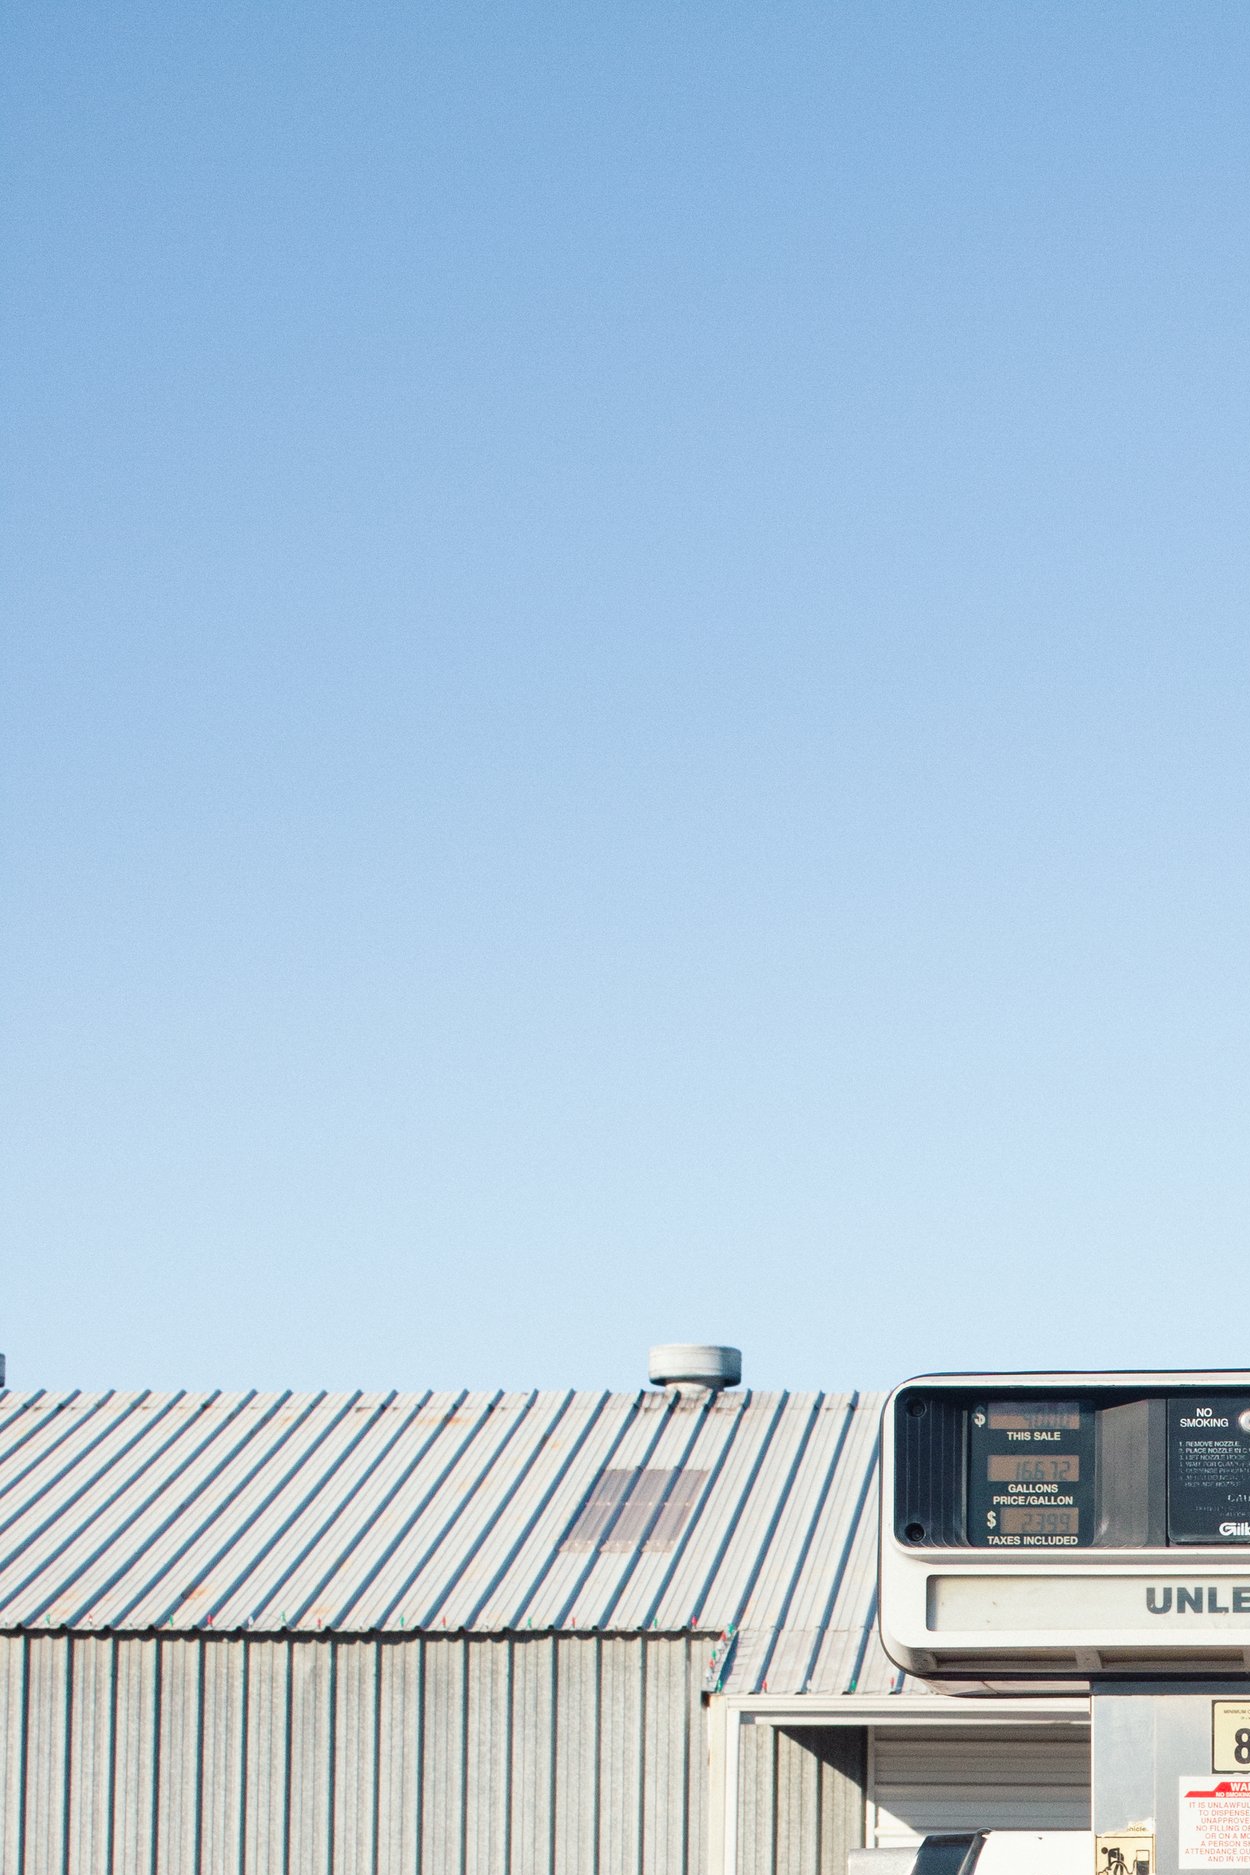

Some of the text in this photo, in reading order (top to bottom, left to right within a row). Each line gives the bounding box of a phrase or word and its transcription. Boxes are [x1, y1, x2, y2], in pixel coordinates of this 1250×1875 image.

[1196, 1408, 1212, 1417] NO
[1180, 1418, 1229, 1427] SMOKING
[1007, 1432, 1061, 1440] THIS SALE
[1008, 1484, 1058, 1493] GALLONS
[993, 1496, 1073, 1505] PRICE/GALLON
[987, 1510, 996, 1529] $
[987, 1536, 1078, 1545] TAXES INCLUDED
